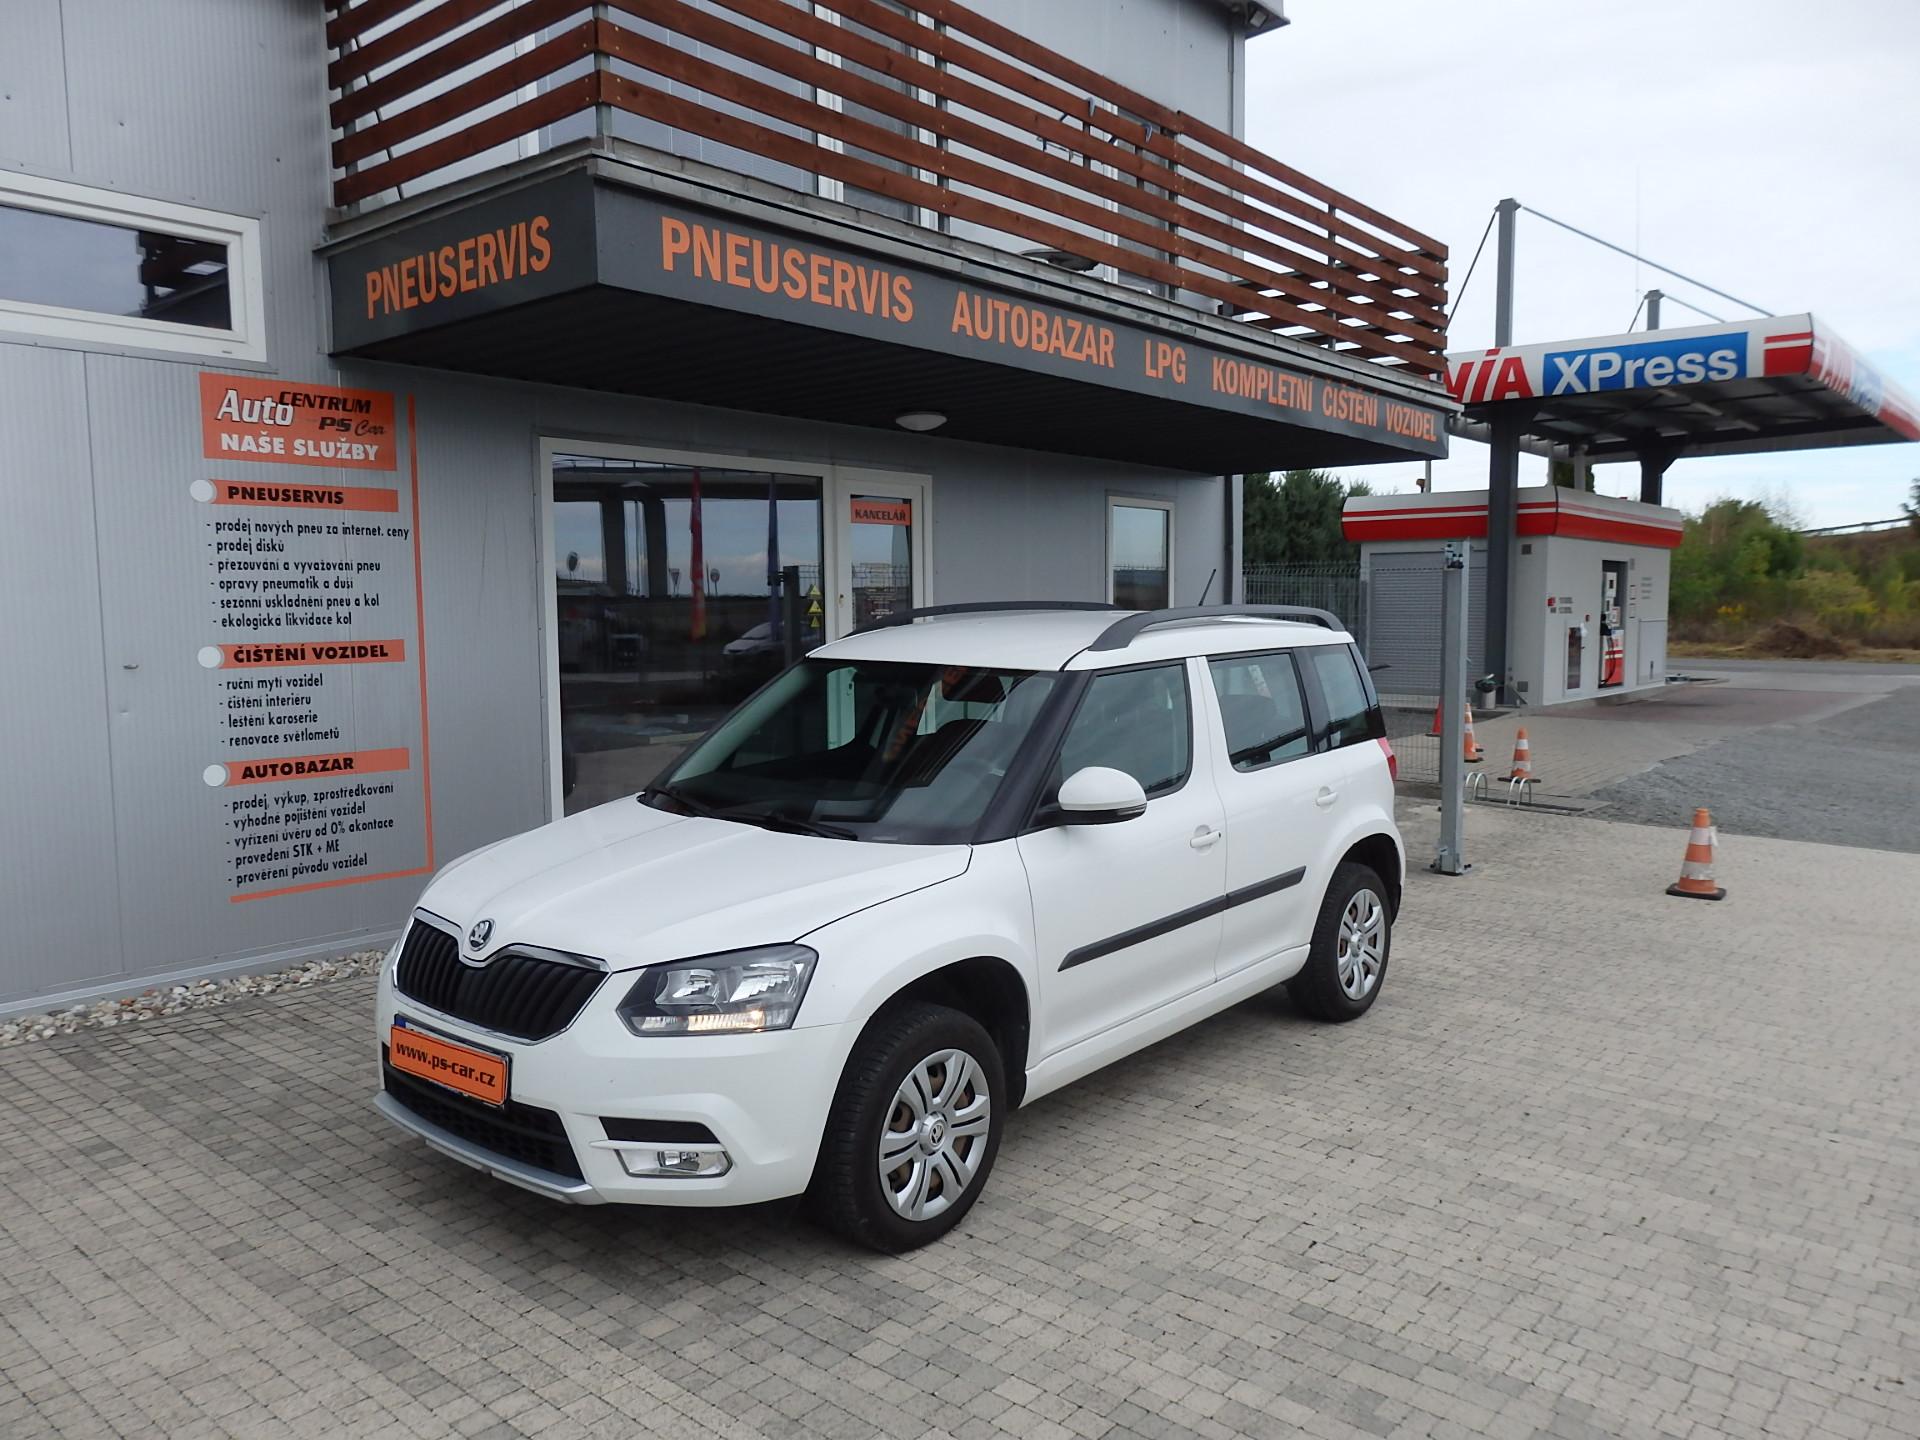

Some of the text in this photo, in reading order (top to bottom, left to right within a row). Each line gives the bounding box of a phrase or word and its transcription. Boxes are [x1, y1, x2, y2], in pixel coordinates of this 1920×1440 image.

[366, 215, 552, 320] PNEUSERVIS
[661, 216, 914, 323] PNEUSERVIS
[952, 291, 1115, 368] AUTOBAZAR
[1144, 339, 1187, 385] LPG
[1212, 356, 1314, 412] KOMPLETNÍ
[1385, 402, 1437, 442] VOZIDEL
[1442, 347, 1738, 406] VIA XPress
[216, 388, 371, 426] Auto CENTRUM
[318, 416, 386, 437] PS Car
[220, 430, 379, 461] NAŠE SLUŽBY
[227, 485, 344, 504] PNEUSERVIS
[215, 518, 409, 541] prodej nových pneu za internet. ceny
[217, 537, 252, 555] prodej
[283, 562, 290, 571] a
[357, 562, 381, 575] pneu
[219, 580, 259, 593] opravy
[263, 576, 320, 593] pneumatik
[323, 580, 330, 589] a
[326, 597, 352, 611] pneu
[354, 598, 361, 607] a
[364, 592, 380, 608] kol
[221, 611, 352, 631] ekologická likvidace kol
[233, 644, 389, 663] ČIŠTĚNÍ VOZIDEL
[286, 672, 323, 688] vozidel
[268, 709, 318, 726] karoserie
[229, 727, 340, 747] renovace světlometů
[241, 757, 355, 780] AUTOBAZAR
[330, 800, 366, 817] vozidel
[315, 822, 327, 837] od
[330, 820, 346, 835] 0%
[348, 818, 394, 833] akontace
[293, 842, 314, 858] STK
[326, 838, 341, 854] ME
[292, 858, 330, 879] původu
[332, 852, 368, 870] vozidel
[396, 1042, 496, 1088] www.ps-car.cz
